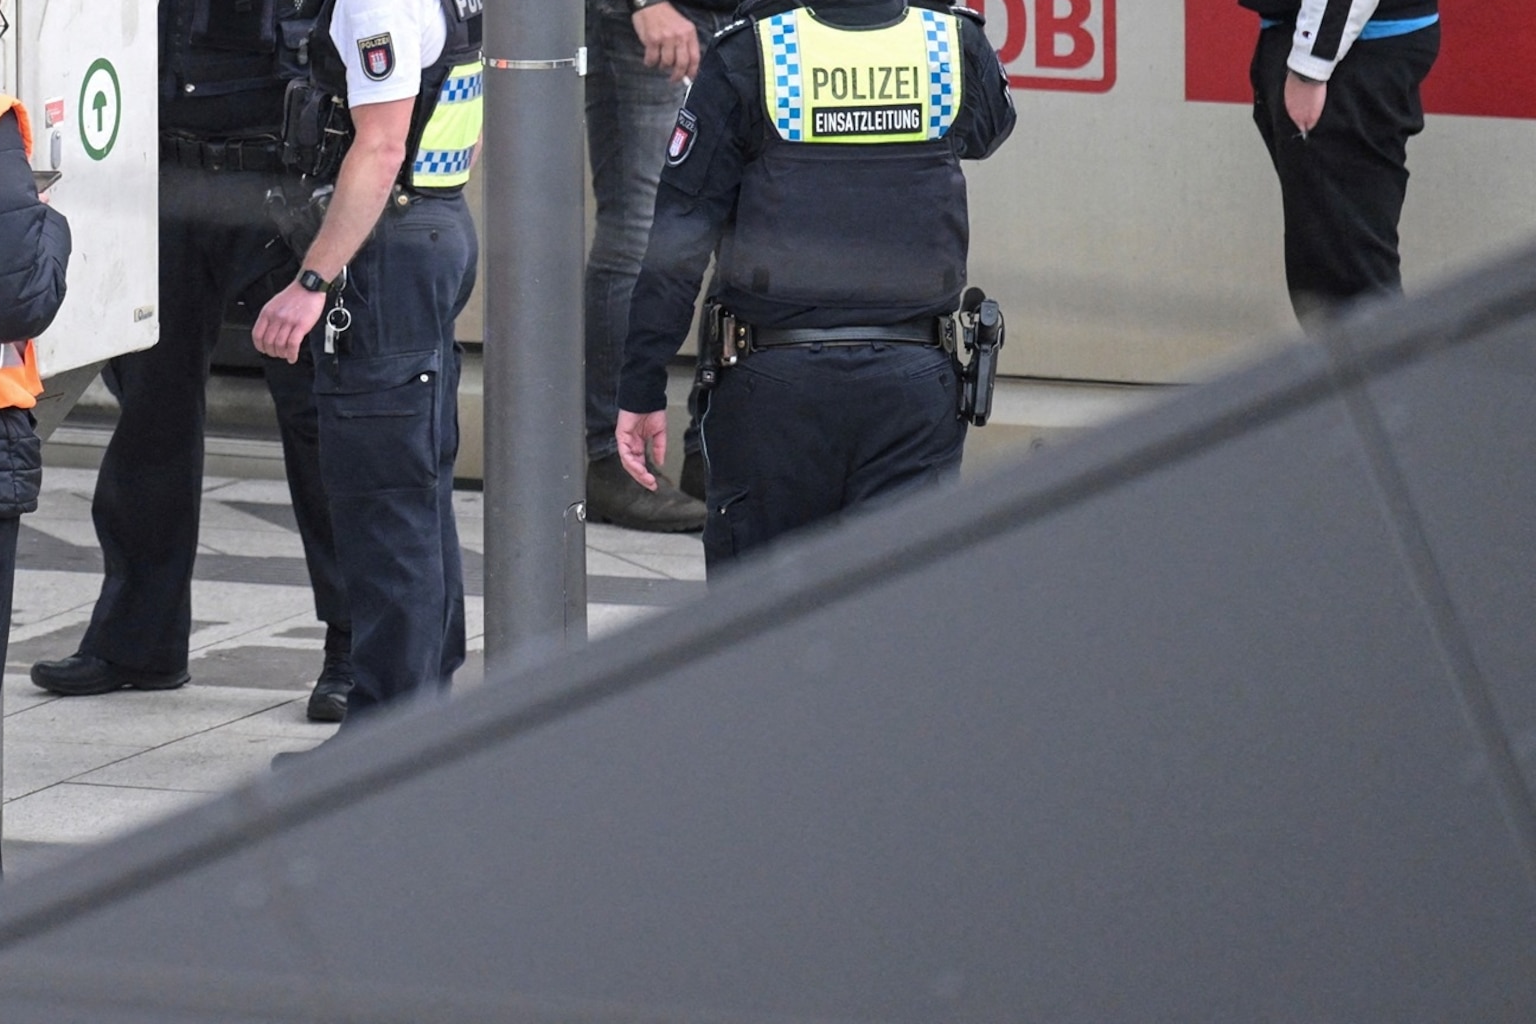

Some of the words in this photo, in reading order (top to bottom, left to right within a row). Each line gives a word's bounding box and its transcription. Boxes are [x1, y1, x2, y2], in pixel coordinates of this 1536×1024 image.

[360, 36, 391, 50] POLIZEI
[812, 66, 920, 100] POLIZEI
[815, 108, 921, 134] EINSATZLEITUNG
